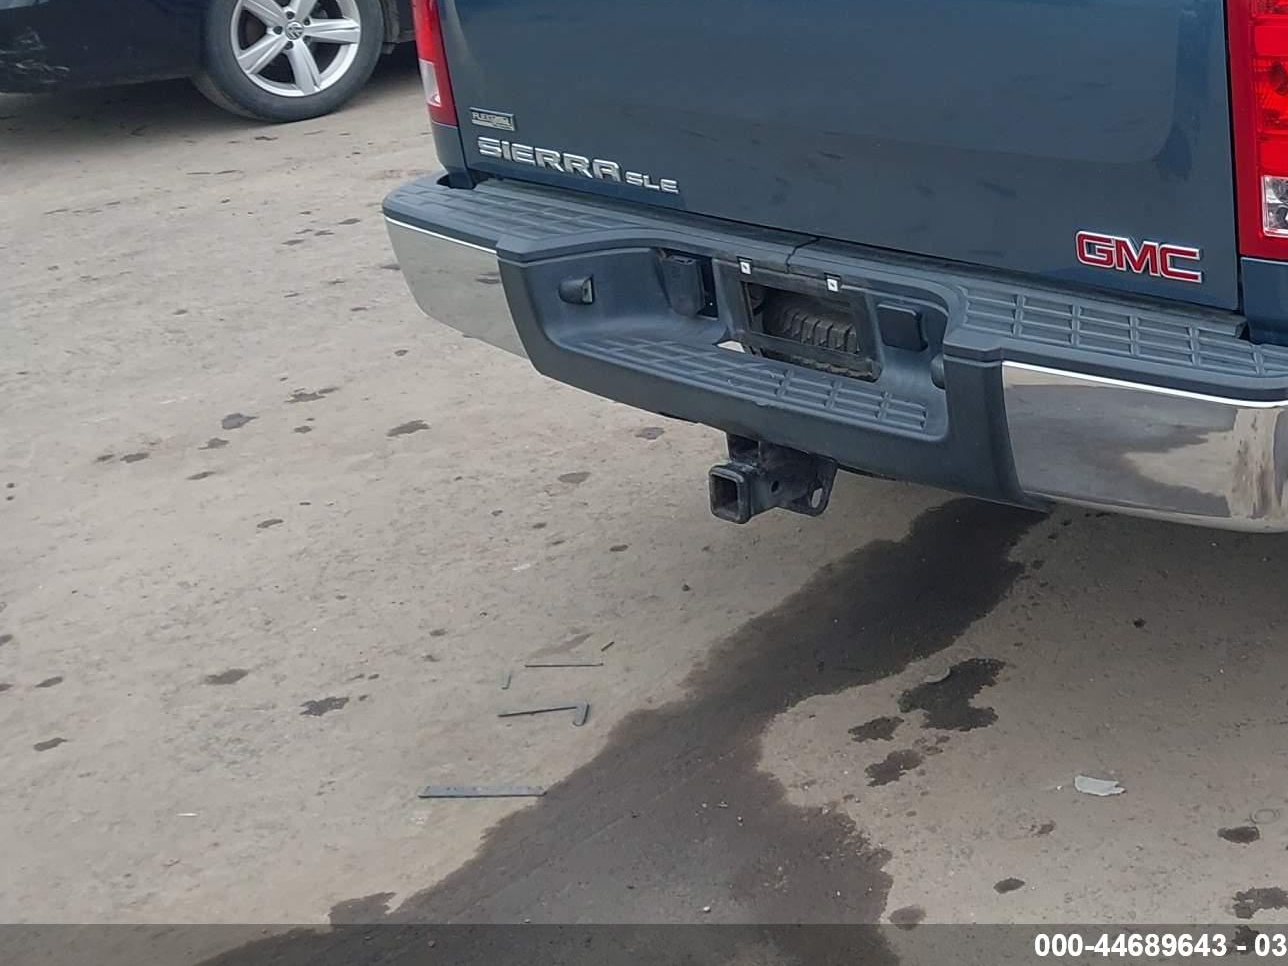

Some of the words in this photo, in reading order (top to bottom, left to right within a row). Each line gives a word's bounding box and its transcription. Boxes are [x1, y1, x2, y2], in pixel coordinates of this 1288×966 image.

[477, 136, 623, 182] SIERRA
[624, 170, 680, 195] SLE
[1075, 230, 1202, 284] GMC
